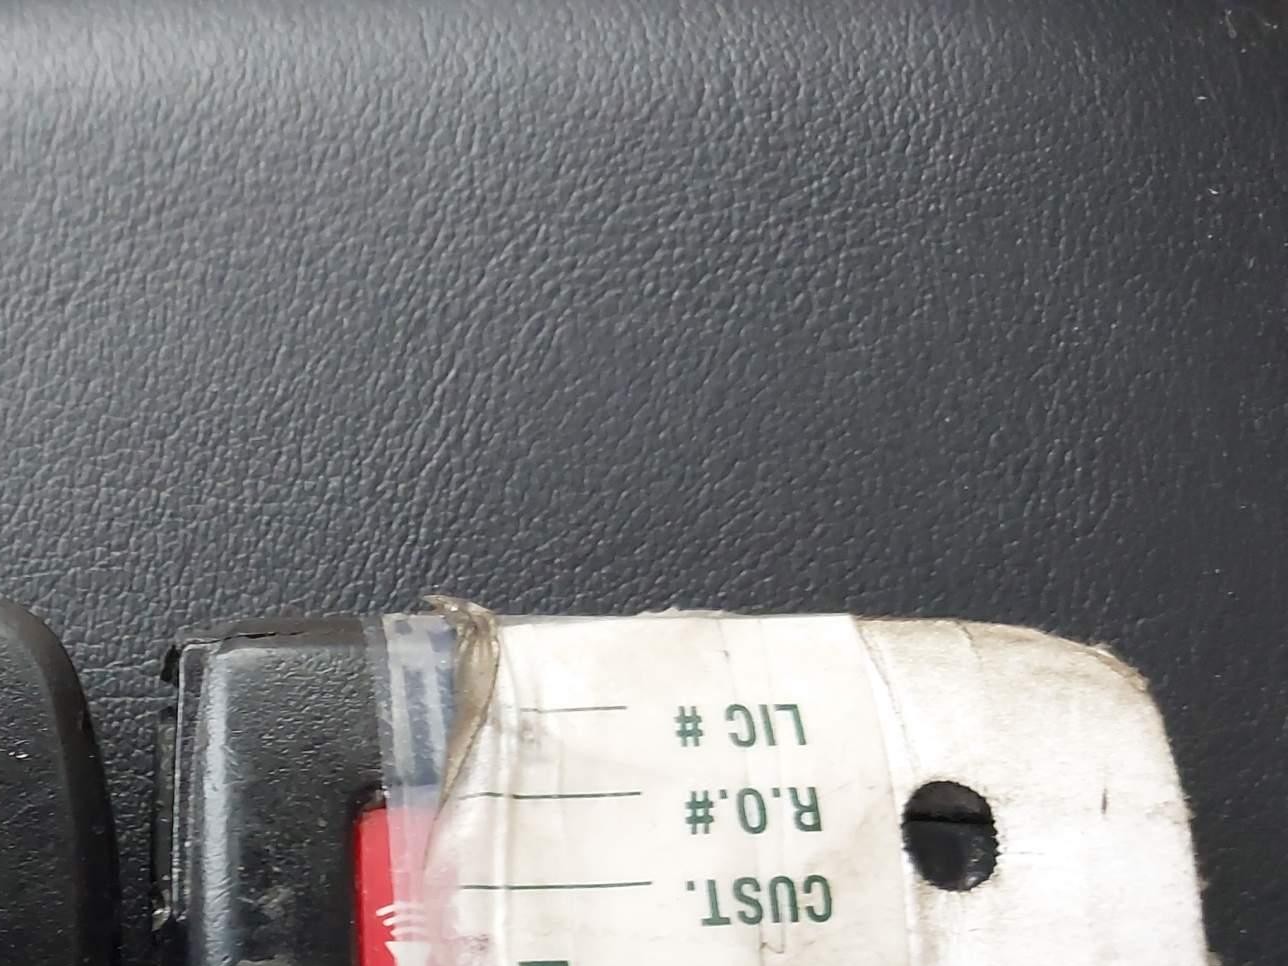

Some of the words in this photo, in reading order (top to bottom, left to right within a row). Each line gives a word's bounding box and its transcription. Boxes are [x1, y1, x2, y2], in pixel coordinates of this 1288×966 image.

[674, 705, 703, 747] #
[725, 703, 808, 747] LIC
[684, 786, 823, 835] R.O.#
[686, 874, 833, 926] CUST.
